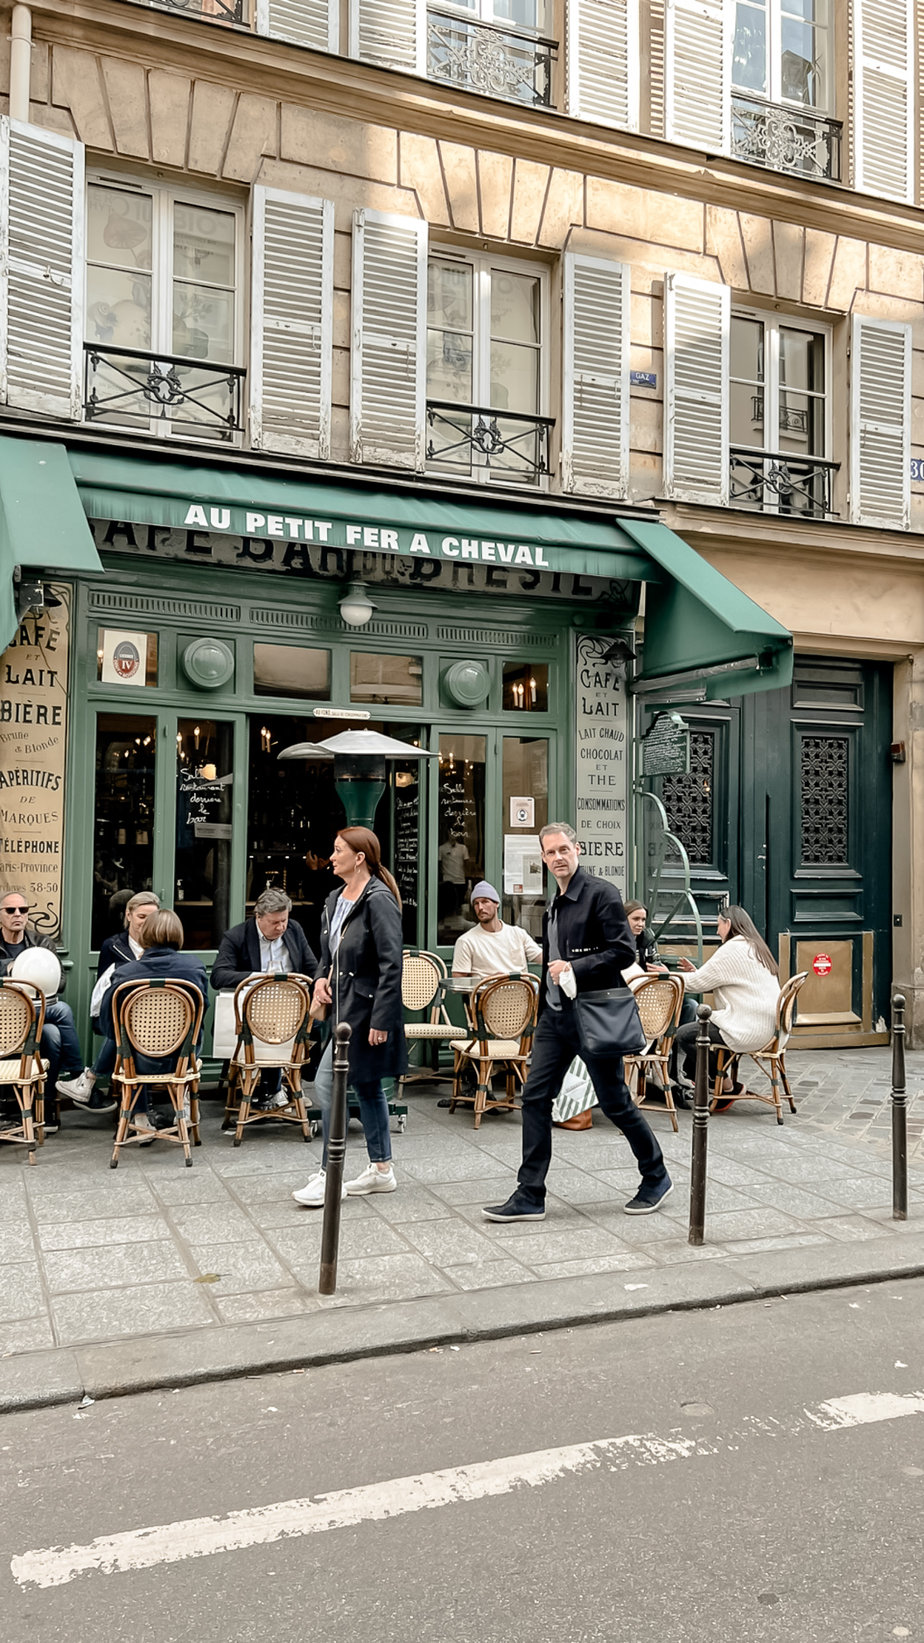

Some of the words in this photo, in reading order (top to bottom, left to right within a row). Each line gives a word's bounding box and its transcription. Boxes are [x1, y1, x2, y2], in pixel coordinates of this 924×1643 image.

[635, 372, 650, 381] GAZ
[184, 505, 230, 529] AU
[246, 511, 332, 542] PETIT
[346, 524, 399, 550] FER
[409, 533, 431, 554] A
[441, 536, 549, 567] CHEVAL
[121, 660, 133, 670] IV
[5, 664, 58, 687] LAIT
[0, 700, 62, 725] BIÈRE
[582, 697, 619, 716] LAIT
[578, 728, 596, 741] LAIT
[599, 727, 625, 743] CHAUD
[25, 736, 59, 754] Blonde
[580, 748, 623, 761] CHOCOLAT
[0, 766, 62, 791] APÉRITIFS
[587, 774, 616, 786] THE
[20, 796, 36, 804] DE
[0, 809, 59, 827] MARQUES
[186, 812, 207, 824] bar
[581, 820, 592, 829] DE
[596, 820, 621, 829] CHOIX
